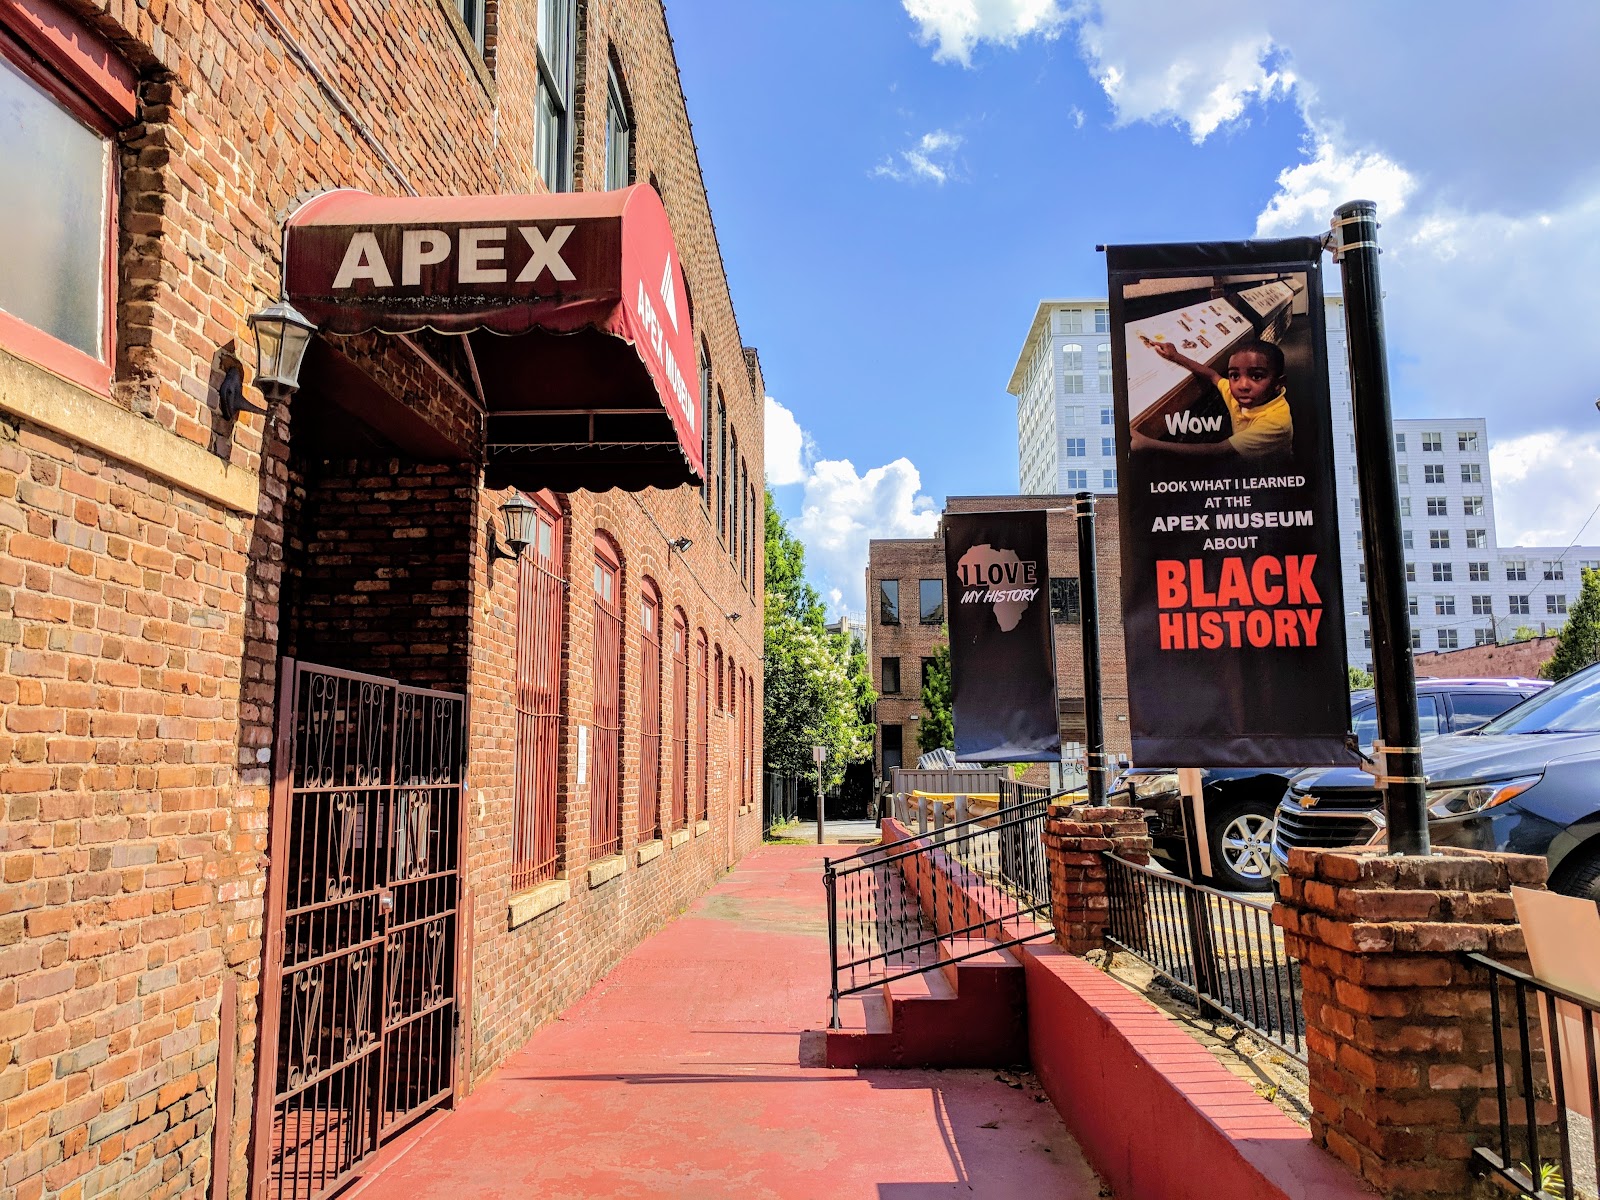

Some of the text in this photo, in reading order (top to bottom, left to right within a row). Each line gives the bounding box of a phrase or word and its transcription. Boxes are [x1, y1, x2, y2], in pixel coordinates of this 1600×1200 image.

[331, 224, 577, 289] APEX
[637, 278, 696, 435] APEX MUSEUM
[1150, 475, 1306, 494] LOOK WHAT I LEARNED
[1204, 496, 1252, 509] AT THE
[1151, 510, 1314, 533] APEX MUSEUM
[1202, 536, 1258, 551] ABOUT
[961, 561, 1038, 587] I LOVE
[1156, 554, 1322, 609] BLACK
[960, 588, 1039, 604] MY HISTORY
[1159, 608, 1322, 650] HISTORY
